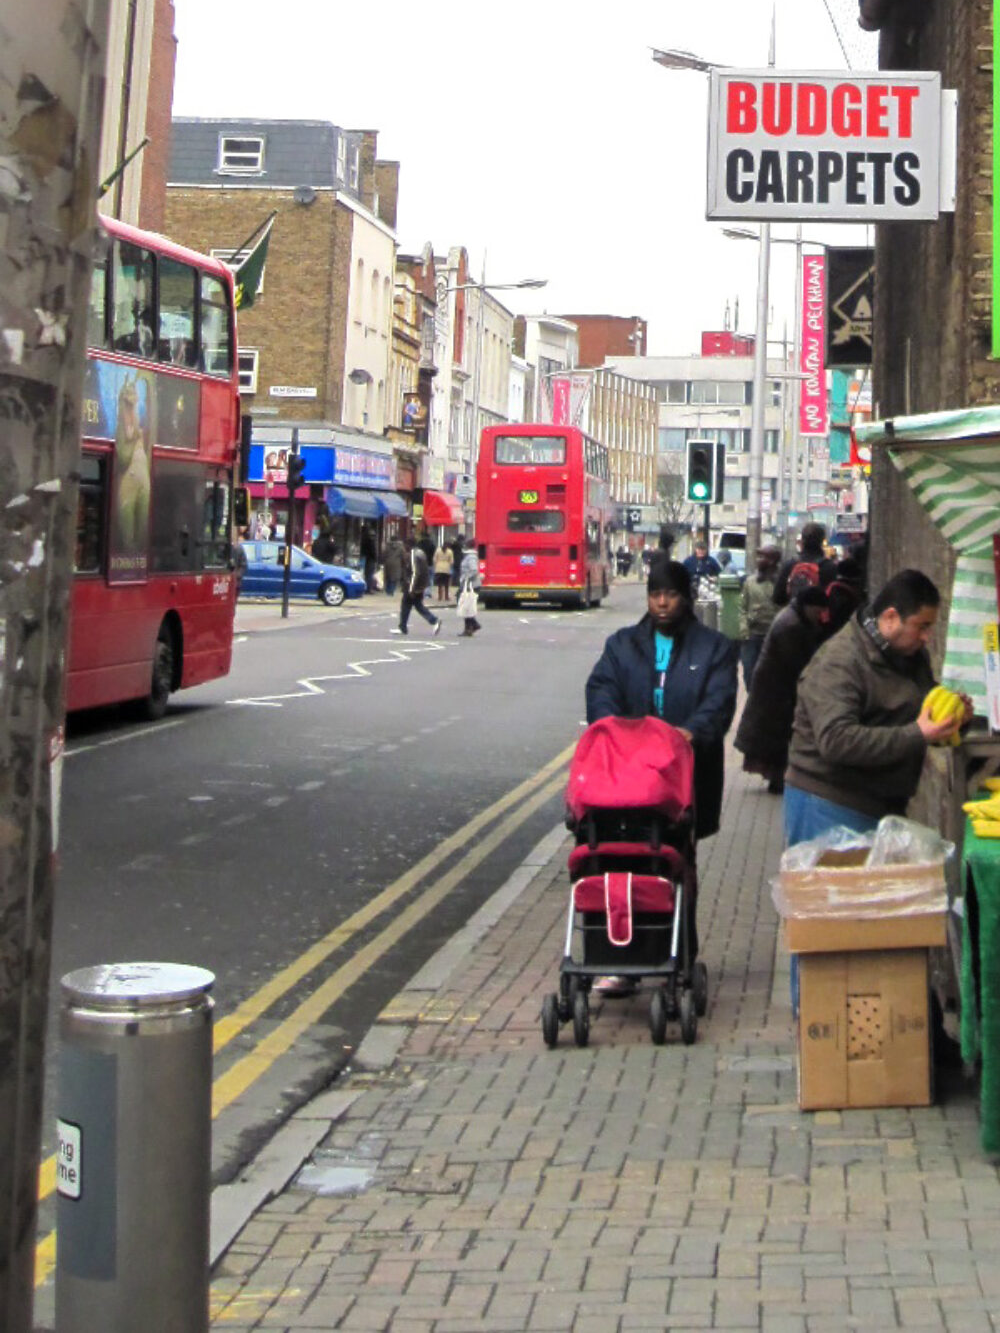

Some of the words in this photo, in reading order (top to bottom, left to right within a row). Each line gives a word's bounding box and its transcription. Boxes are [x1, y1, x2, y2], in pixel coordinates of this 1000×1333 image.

[725, 80, 919, 139] BUDGET
[725, 148, 922, 207] CARPETS
[806, 260, 824, 331] PECKHAM
